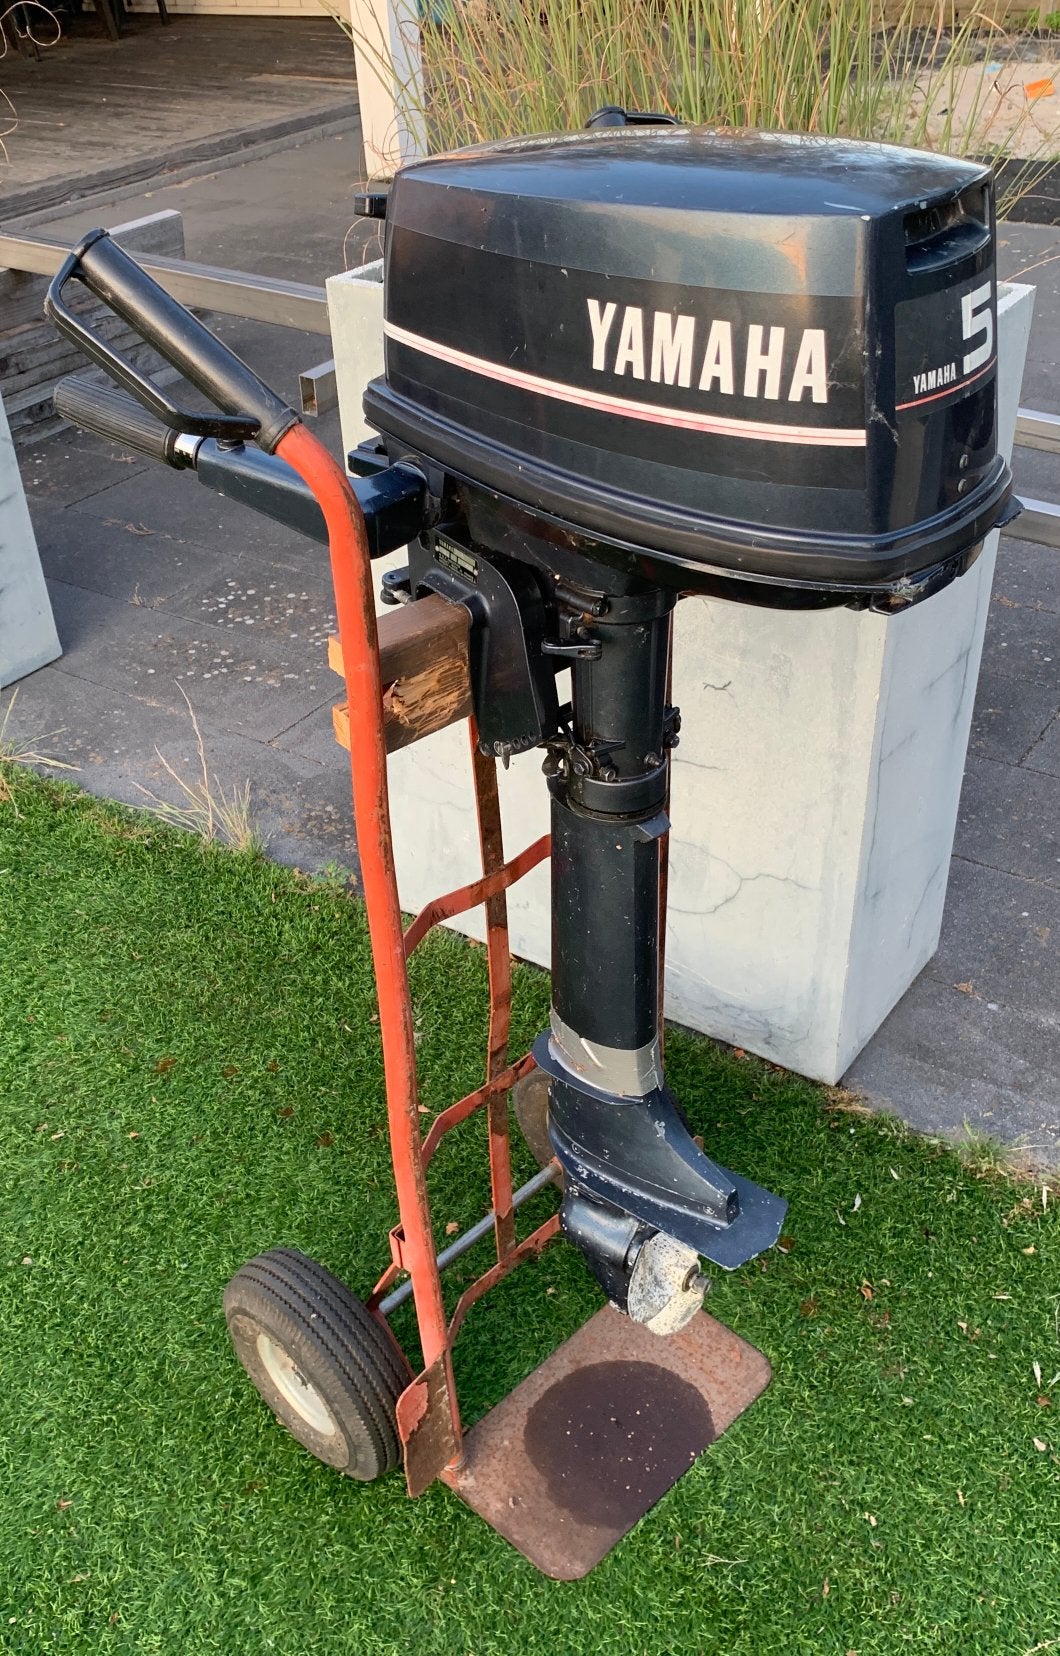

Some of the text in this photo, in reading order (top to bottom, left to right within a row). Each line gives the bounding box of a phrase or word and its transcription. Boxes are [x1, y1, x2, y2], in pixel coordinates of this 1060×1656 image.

[587, 298, 828, 403] YAMAHA
[961, 280, 993, 375] 5
[913, 362, 956, 394] YAMAHA
